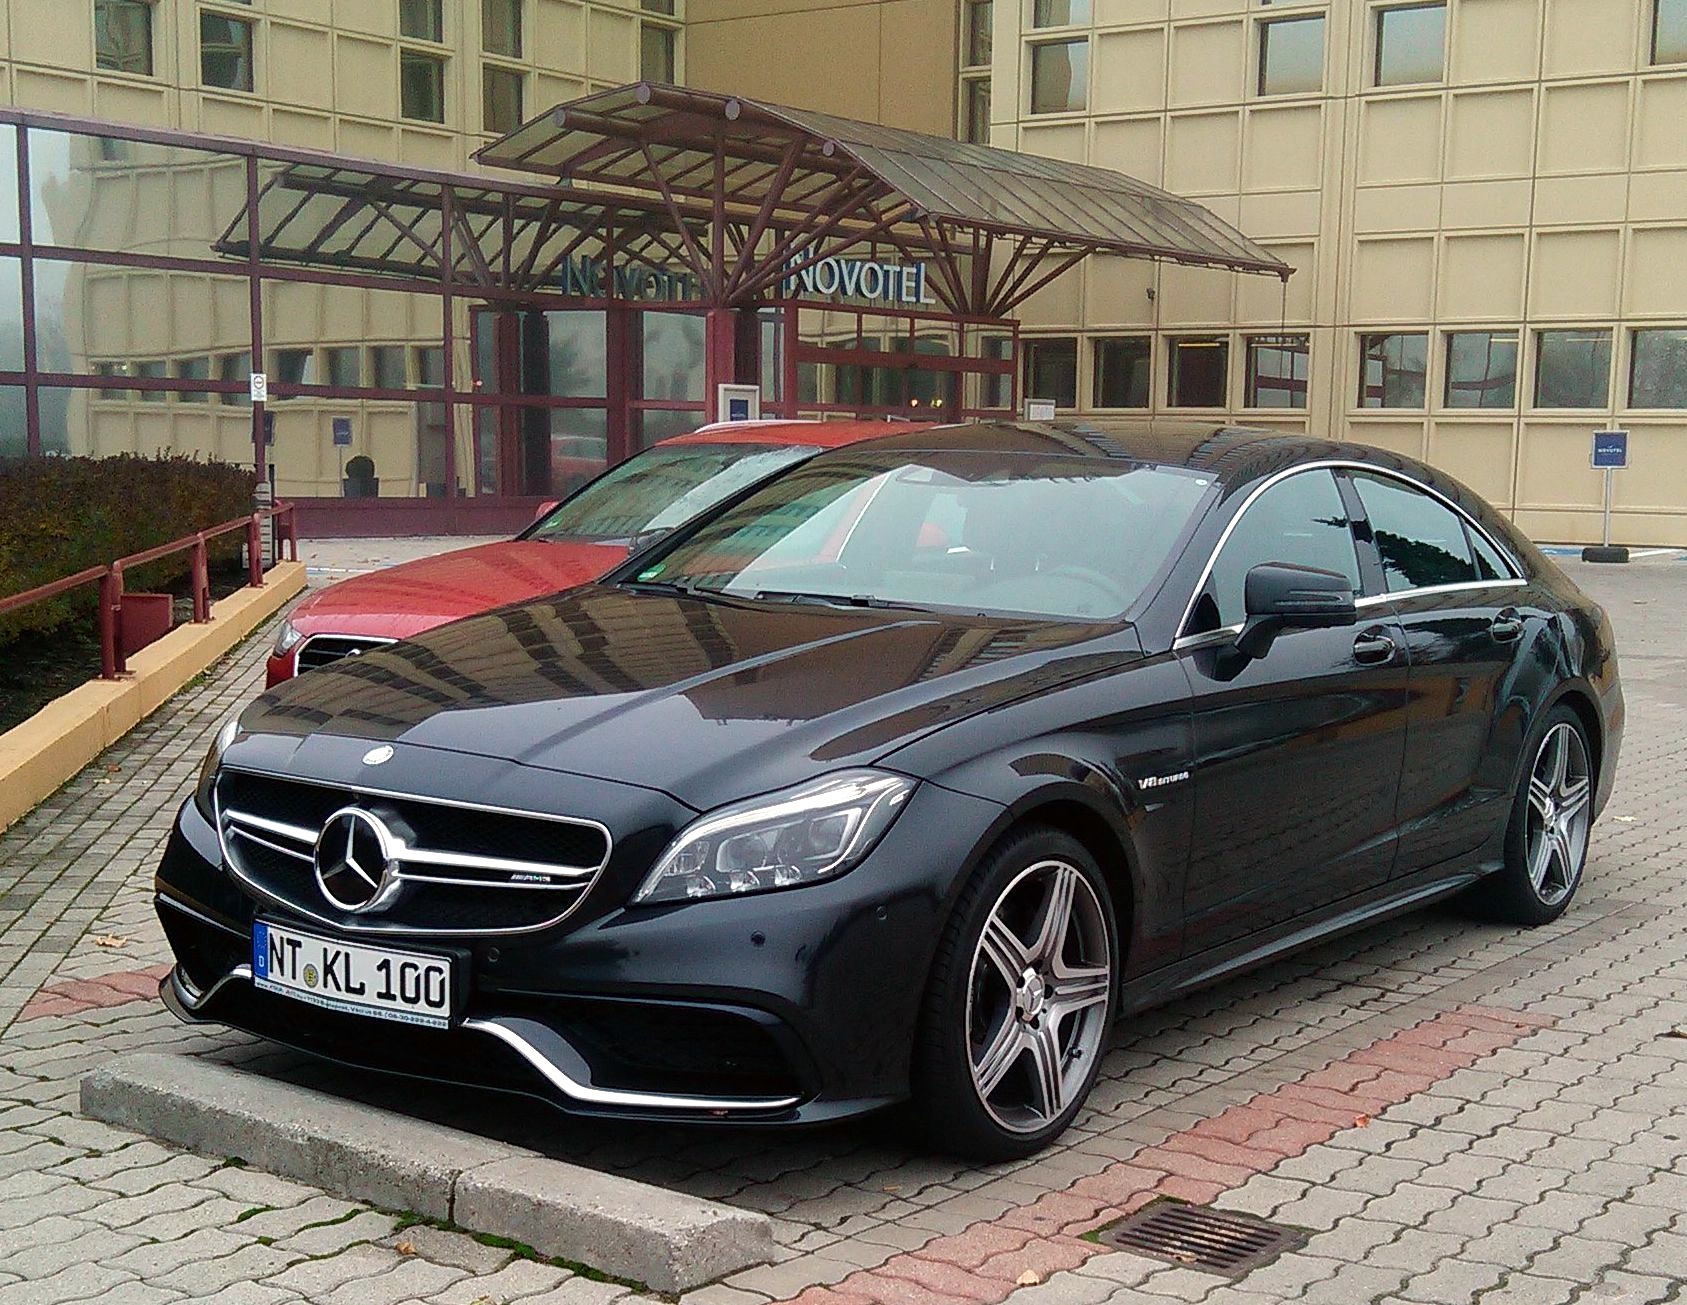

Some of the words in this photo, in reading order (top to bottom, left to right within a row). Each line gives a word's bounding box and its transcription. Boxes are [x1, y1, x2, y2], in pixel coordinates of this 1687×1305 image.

[786, 243, 936, 304] NOVOTEL
[269, 932, 303, 980] NT
[322, 947, 366, 996] KL
[376, 958, 446, 1009] 100
